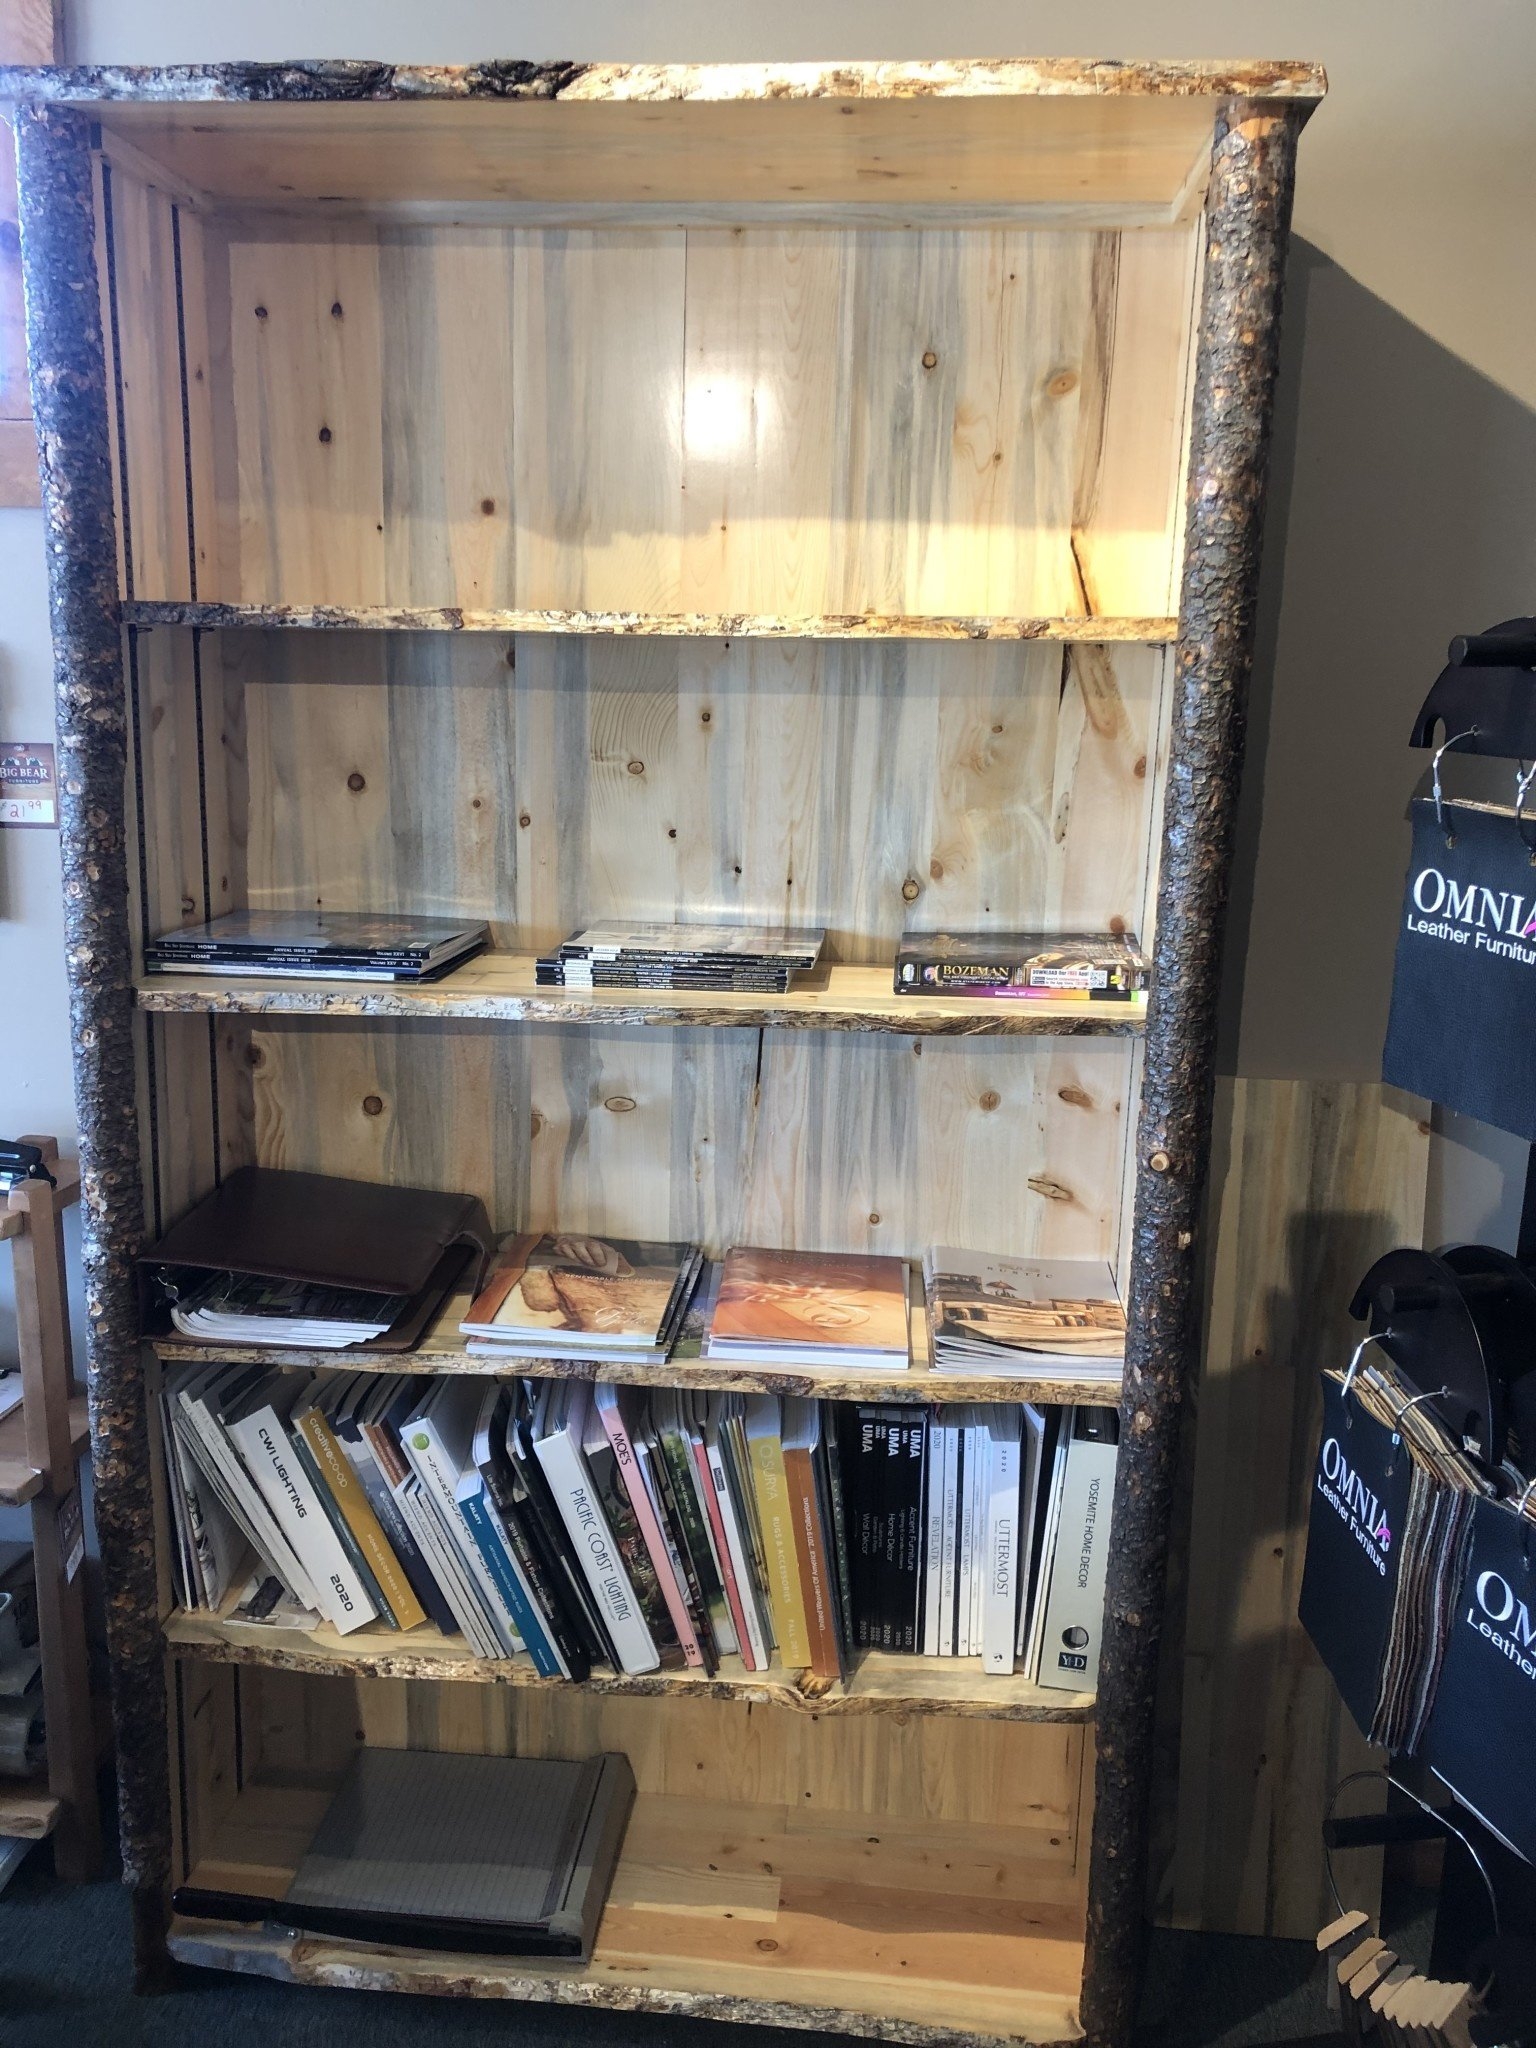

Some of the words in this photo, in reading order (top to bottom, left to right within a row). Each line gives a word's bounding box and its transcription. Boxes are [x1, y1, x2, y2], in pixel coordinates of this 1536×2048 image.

[0, 767, 18, 779] BIG
[20, 767, 49, 779] BEAR
[1407, 914, 1471, 945] Leather
[943, 965, 1009, 976] BOZEMAN
[612, 1432, 632, 1466] MOE'S
[862, 1424, 873, 1453] UMA
[888, 1427, 900, 1457] UMA
[909, 1429, 922, 1459] UMA
[933, 1430, 942, 1449] 2020
[761, 1460, 779, 1501] SURYA
[1322, 1438, 1391, 1552] OMNIA
[427, 1455, 478, 1547] INTERMOUNTAIN
[468, 1502, 483, 1525] KALATY
[803, 1497, 813, 1531] Collections
[1085, 1478, 1101, 1524] YOSEMITE
[258, 1427, 276, 1456] CWI
[272, 1456, 307, 1519] LIGHTING
[330, 1573, 354, 1612] 2020
[508, 1521, 519, 1537] 2019
[773, 1516, 782, 1538] RUGS
[862, 1513, 871, 1531] Wall
[887, 1513, 896, 1537] Home
[908, 1506, 917, 1534] Accent
[963, 1508, 971, 1548] UTTERMOST
[1317, 1474, 1348, 1522] Leather
[1350, 1516, 1386, 1576] Furniture
[496, 1524, 509, 1545] KALATY
[515, 1537, 529, 1561] Portable
[807, 1531, 815, 1547] 2019
[930, 1516, 941, 1571] REVELATION
[1082, 1525, 1094, 1556] HOME
[525, 1559, 532, 1567] &
[570, 1487, 597, 1531] PACIFIC
[603, 1576, 632, 1622] LIGHTING
[809, 1551, 818, 1576] America
[907, 1535, 917, 1571] Furniture
[962, 1554, 970, 1576] LAMPS
[996, 1519, 1011, 1598] UTTERMOST
[527, 1566, 540, 1588] Fixture
[777, 1549, 791, 1604] ACCESSORIES
[812, 1576, 820, 1584] Of
[1077, 1556, 1091, 1589] DECOR
[537, 1586, 555, 1620] Collections
[814, 1585, 823, 1608] Weavers
[818, 1608, 826, 1631] United
[883, 1624, 891, 1644] 2020
